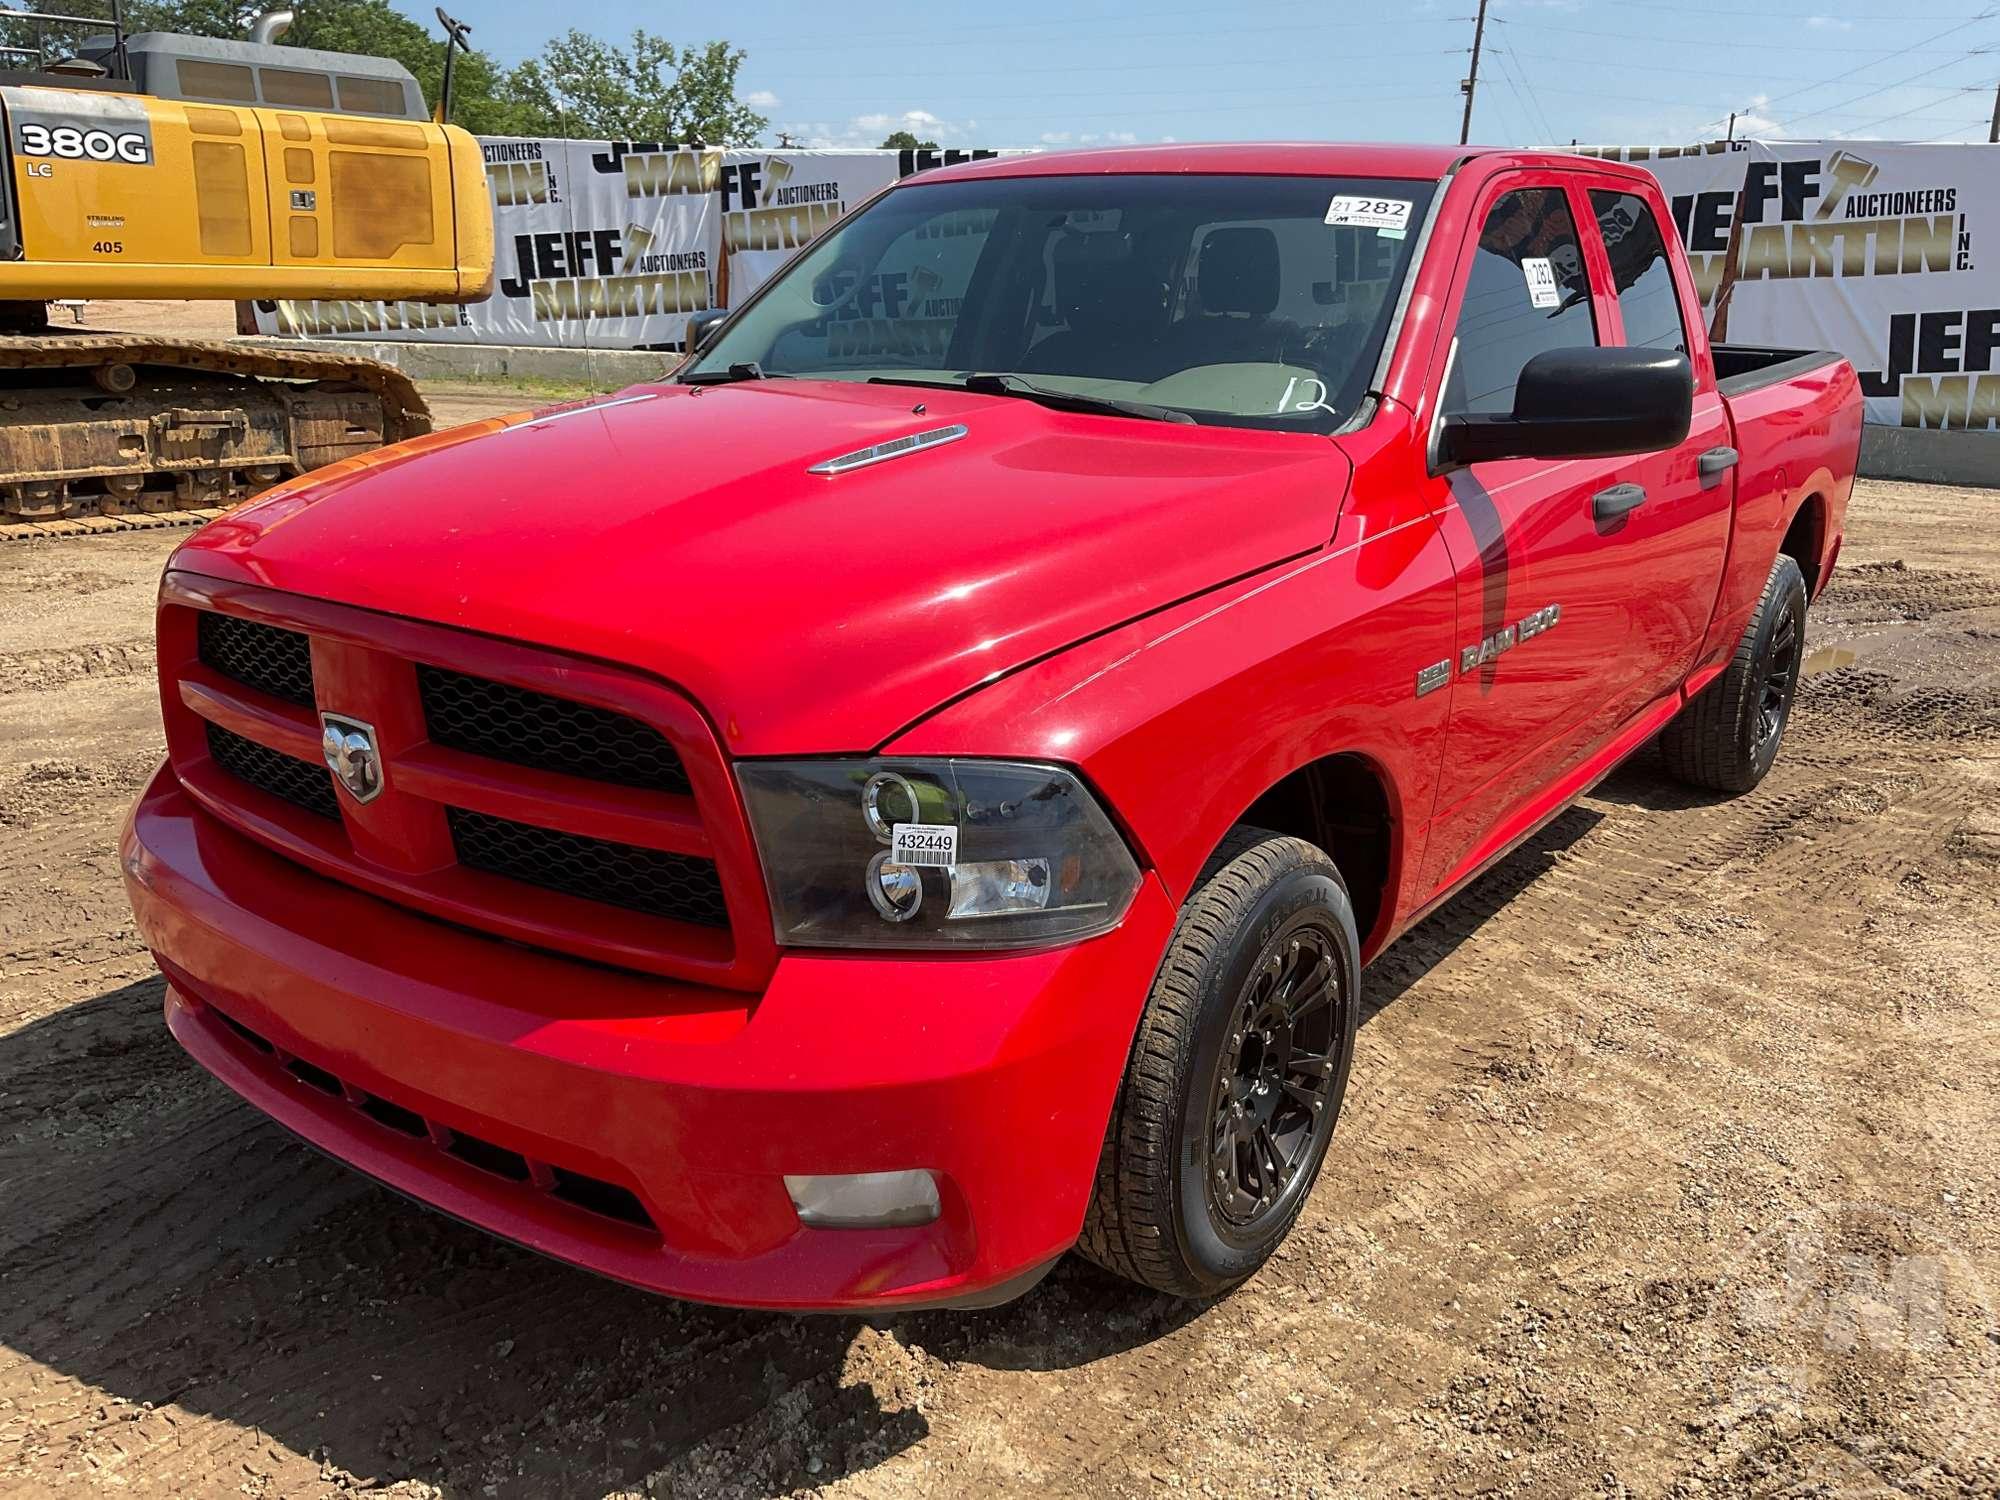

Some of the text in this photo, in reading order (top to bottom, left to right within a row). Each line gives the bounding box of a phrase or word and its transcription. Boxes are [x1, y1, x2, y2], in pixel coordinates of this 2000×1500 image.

[20, 124, 148, 164] 380G
[483, 142, 542, 163] CTIONEERS
[27, 163, 52, 177] LC
[777, 181, 838, 205] AUCTIONEERS
[1845, 188, 1957, 218] AUCTIONEERS
[1356, 201, 1406, 217] 282
[93, 241, 124, 253] 405
[1955, 213, 1975, 271] INC.
[500, 229, 622, 298] JEFF
[640, 251, 706, 272] AUCTIONEERS
[1532, 262, 1553, 285] 282
[529, 270, 708, 322] MARTIN
[1277, 376, 1337, 415] 12
[1459, 603, 1560, 674] RAM 1500
[897, 834, 953, 850] 432449
